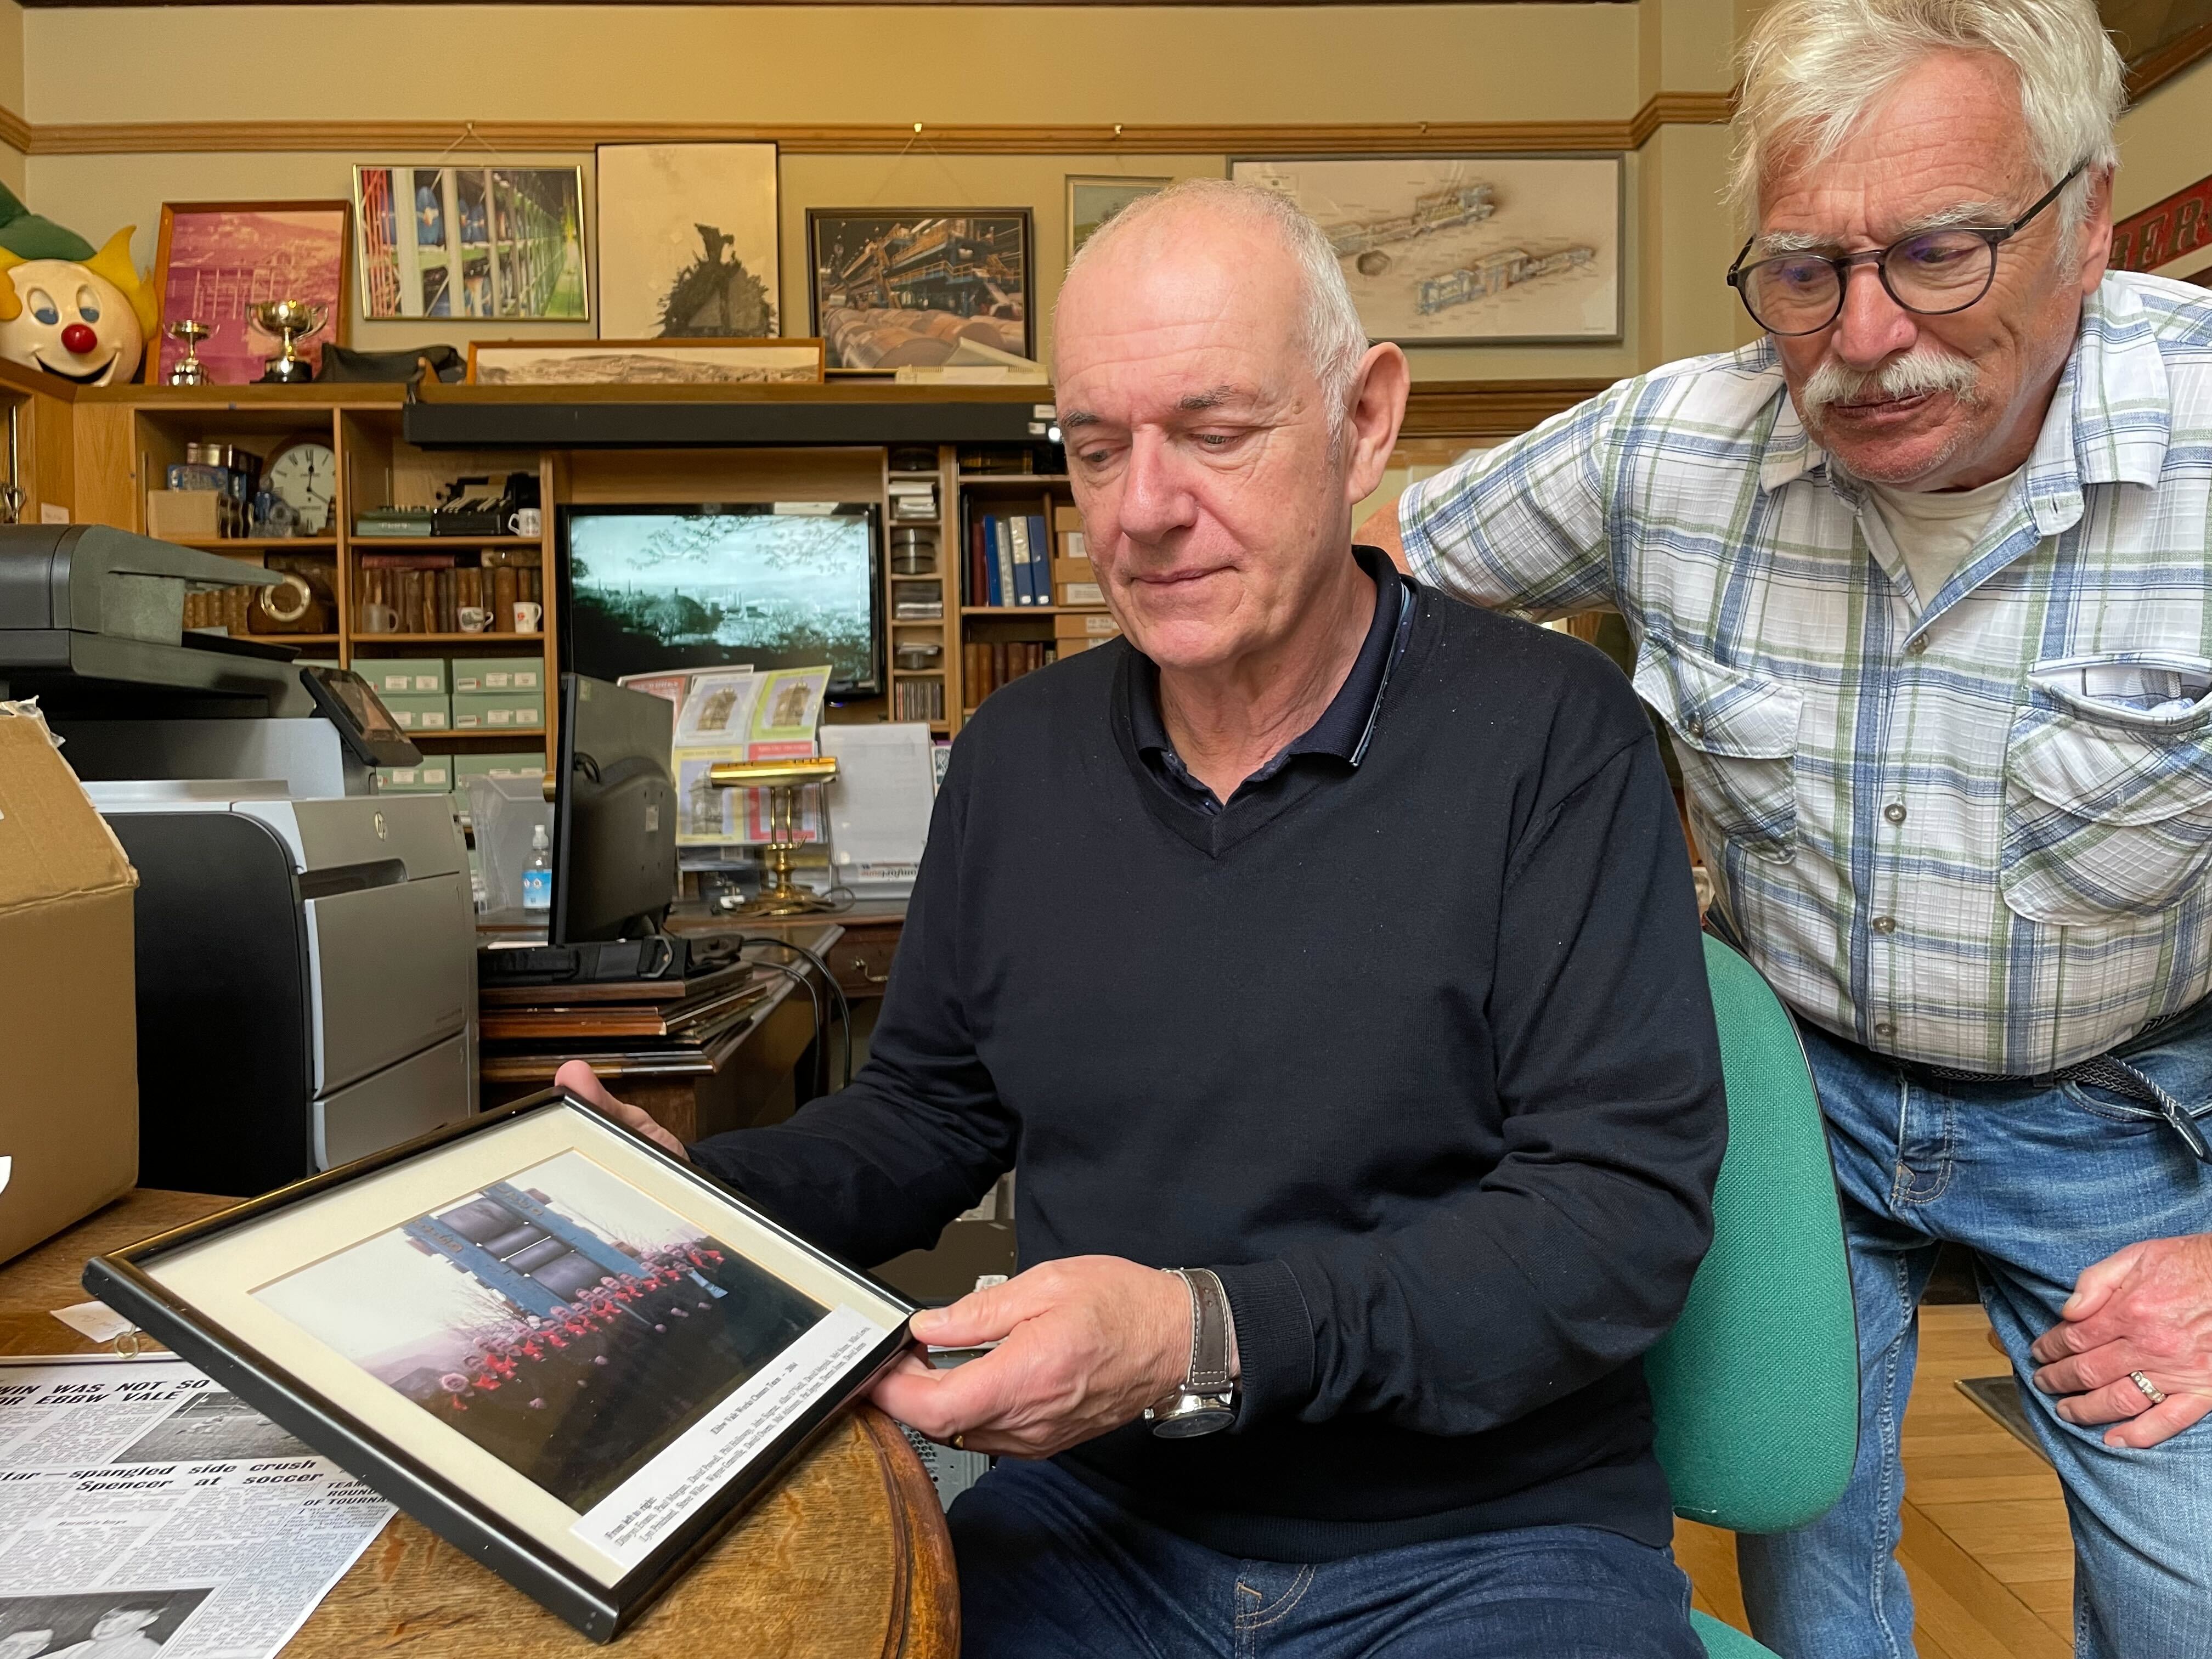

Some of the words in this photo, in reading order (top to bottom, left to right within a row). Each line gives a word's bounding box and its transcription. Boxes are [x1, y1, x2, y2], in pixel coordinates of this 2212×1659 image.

[375, 811, 386, 842] hp
[52, 1383, 106, 1394] WAS
[114, 1381, 168, 1392] NOT
[175, 1379, 211, 1389] SO
[33, 1392, 111, 1404] EBBW
[122, 1390, 184, 1402] VALE
[724, 1413, 739, 1421] Vale
[68, 1465, 178, 1480] spangled
[187, 1463, 238, 1474] side
[249, 1459, 318, 1471] crush
[75, 1480, 175, 1492] Spencer
[194, 1476, 223, 1486] at
[242, 1472, 325, 1485] soccer
[605, 1524, 625, 1539] From
[622, 1515, 635, 1525] left
[640, 1497, 657, 1511] right:
